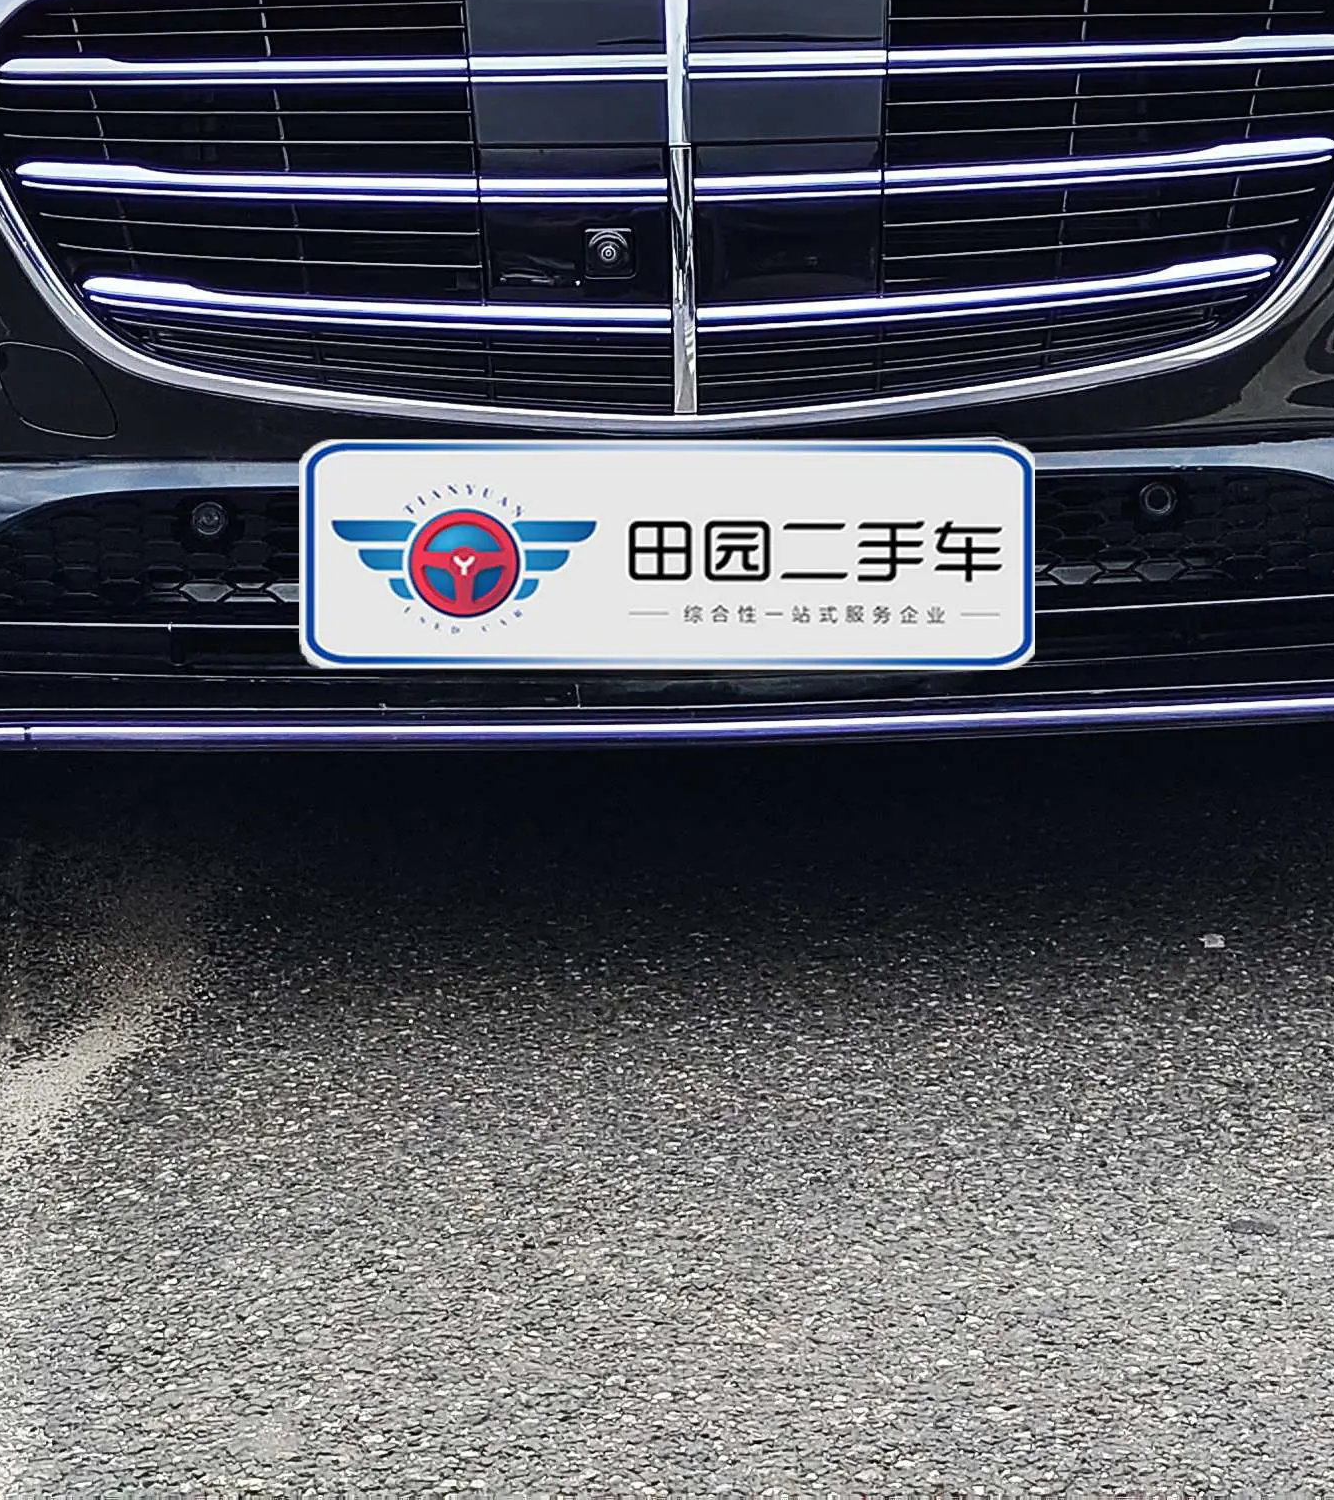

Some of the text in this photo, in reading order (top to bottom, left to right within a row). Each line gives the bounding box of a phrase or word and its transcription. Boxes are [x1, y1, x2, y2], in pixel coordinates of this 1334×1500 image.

[628, 520, 1003, 583] 田园二手车
[683, 604, 946, 625] 综合性一站式服务企业
